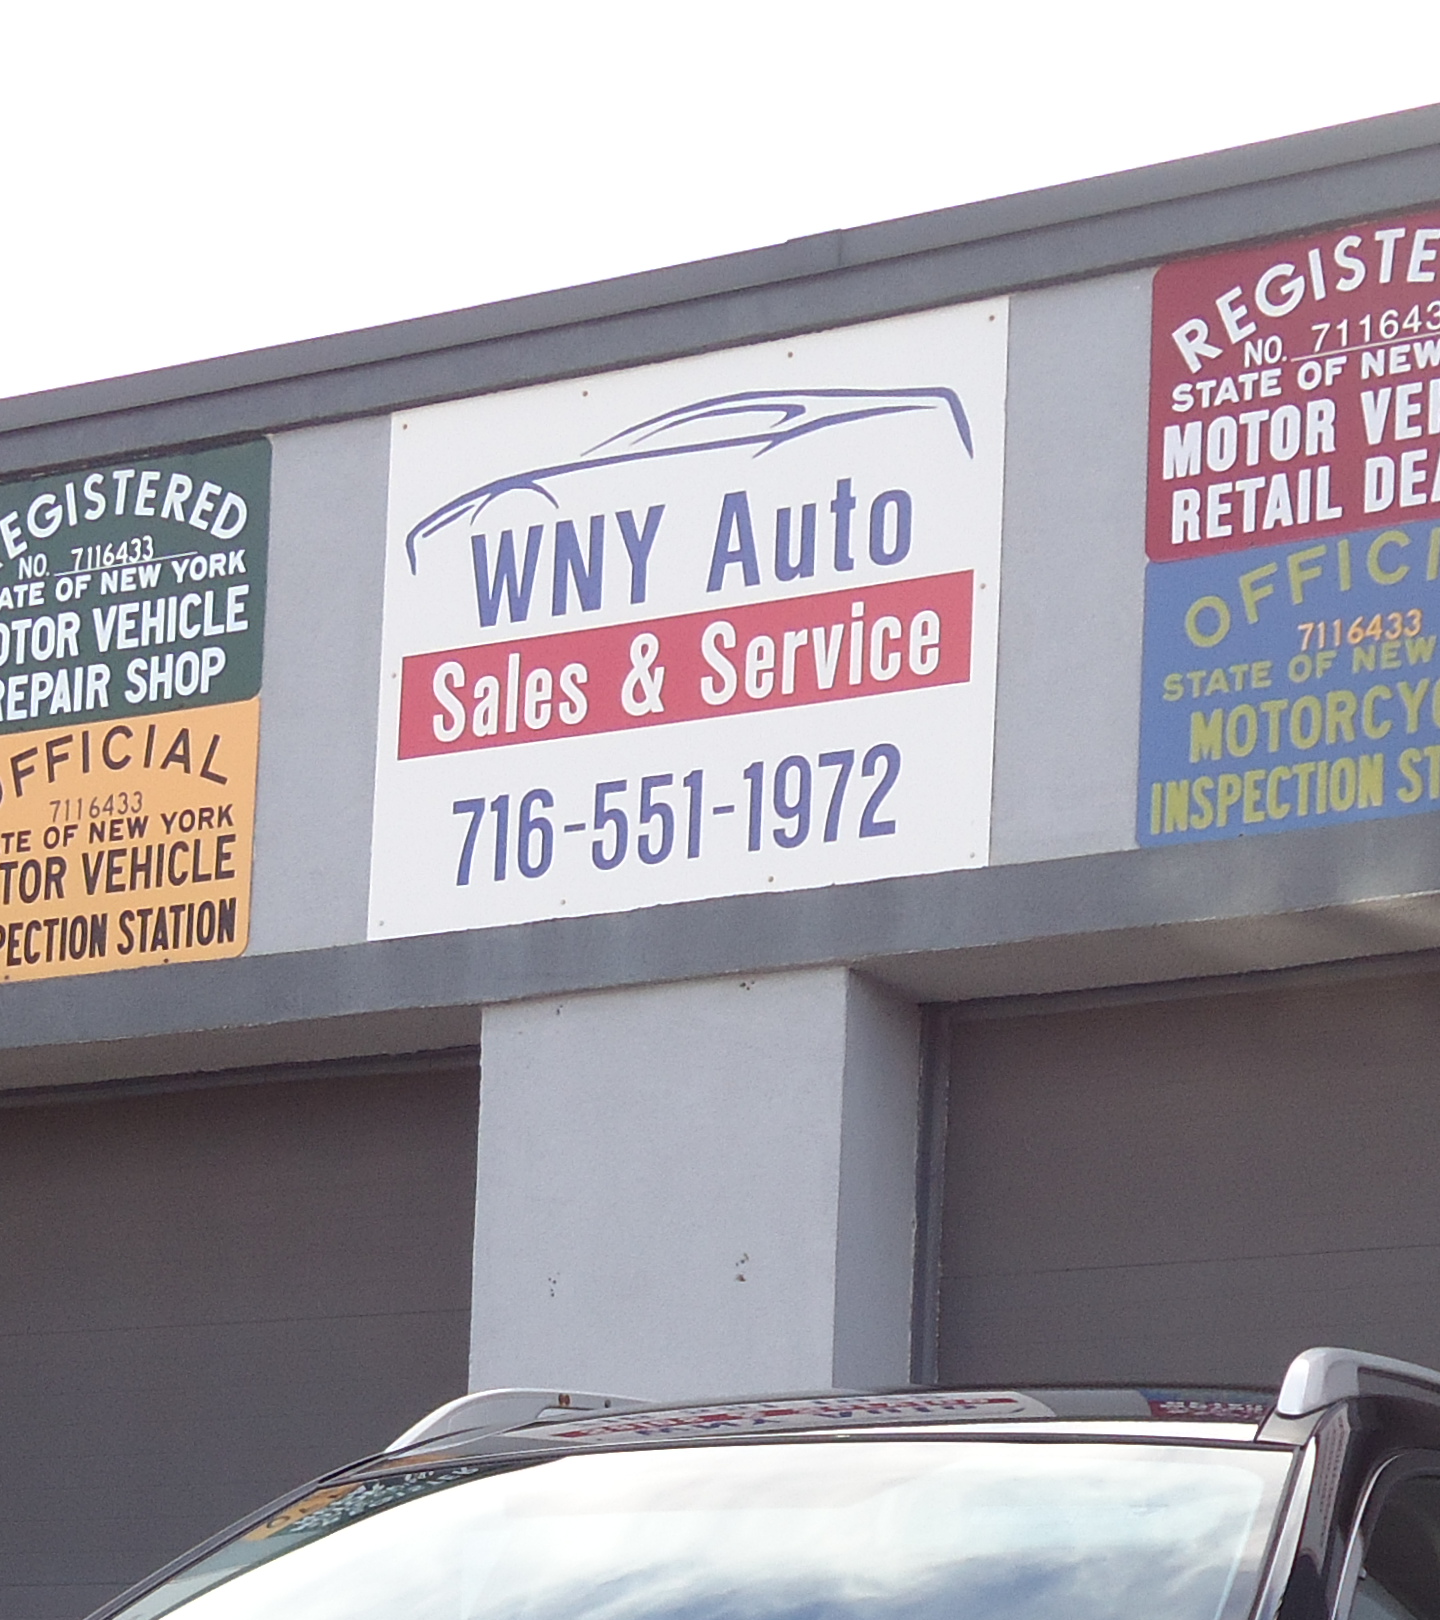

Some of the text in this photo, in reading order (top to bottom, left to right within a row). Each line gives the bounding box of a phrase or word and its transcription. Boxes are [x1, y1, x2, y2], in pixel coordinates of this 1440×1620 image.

[1243, 335, 1288, 368] NO.
[1171, 367, 1282, 412] STATE
[1297, 359, 1343, 391] OF
[1162, 398, 1336, 481] MOTOR
[1171, 465, 1343, 545] RETAIL
[18, 535, 154, 580] NO. 7116433
[55, 574, 88, 601] OF
[100, 563, 161, 595] NEW
[173, 550, 246, 582] YORK
[470, 477, 913, 628] WNY Auto
[92, 584, 249, 653] VEHICLE
[1297, 609, 1423, 653] 7116433
[125, 646, 226, 705] SHOP
[432, 600, 942, 742] Sales & Service
[1163, 657, 1273, 701] STATE
[1288, 650, 1334, 683] OF
[1351, 636, 1437, 674] NEW
[49, 791, 144, 823] 7116433
[452, 742, 901, 886] 716-551-1972
[1150, 753, 1384, 836] INSPECTION
[43, 823, 76, 848] OF
[88, 815, 149, 843] NEW
[160, 804, 234, 835] YORK
[82, 834, 236, 896] VEHICLE
[116, 897, 237, 956] STATION
